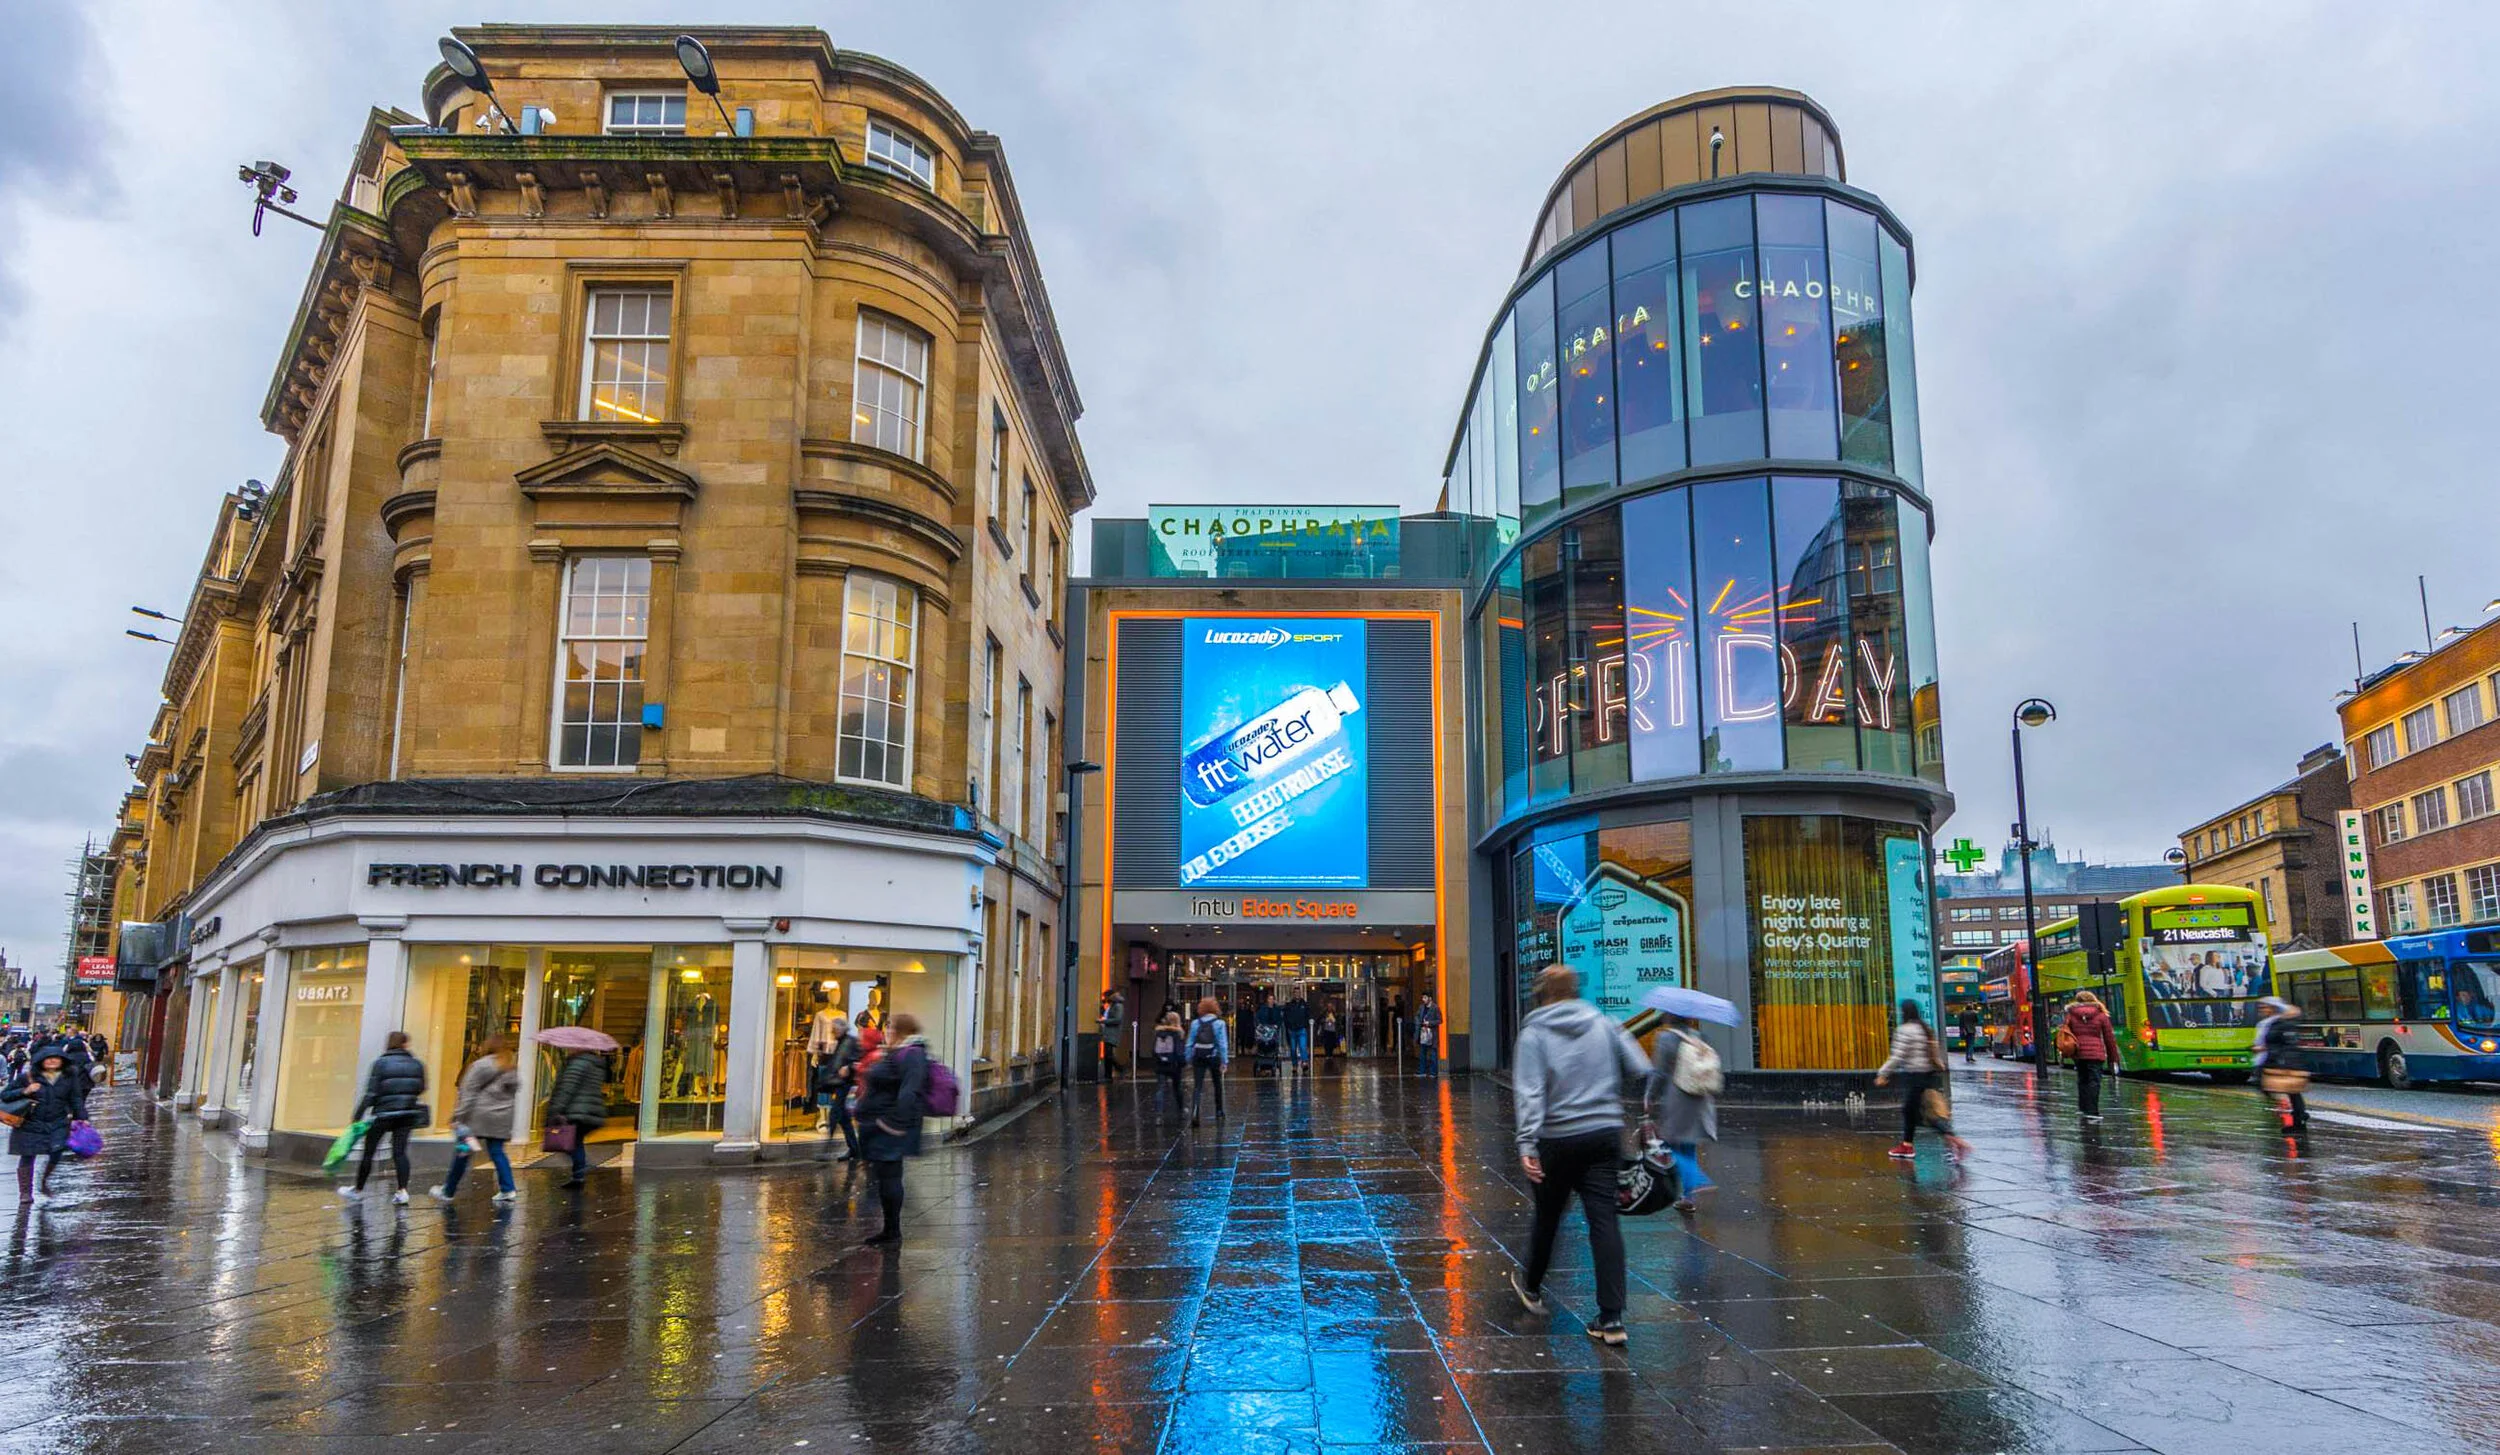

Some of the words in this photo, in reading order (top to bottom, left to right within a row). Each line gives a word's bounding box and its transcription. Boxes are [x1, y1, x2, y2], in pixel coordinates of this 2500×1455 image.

[1160, 517, 1389, 537] CHAOPHRAYA
[1204, 629, 1278, 644] Lucozade
[1293, 634, 1343, 642] SPORT
[367, 864, 522, 887] FRENCH
[533, 864, 783, 889] CONNECTION
[2346, 818, 2371, 931] FENWICK
[1192, 897, 1235, 917] intu
[1241, 899, 1291, 917] Eldon
[1295, 899, 1357, 920] Square
[1761, 895, 1806, 913] Enjoy
[1810, 894, 1841, 910] late
[1762, 913, 1806, 932] night
[1810, 913, 1857, 932] dining
[1859, 917, 1871, 929] at
[1818, 932, 1872, 951] Quarter
[2164, 929, 2177, 942] 21
[2181, 927, 2236, 941] Newcastle
[1636, 967, 1674, 977] TAPAS
[1782, 970, 1811, 980] shops
